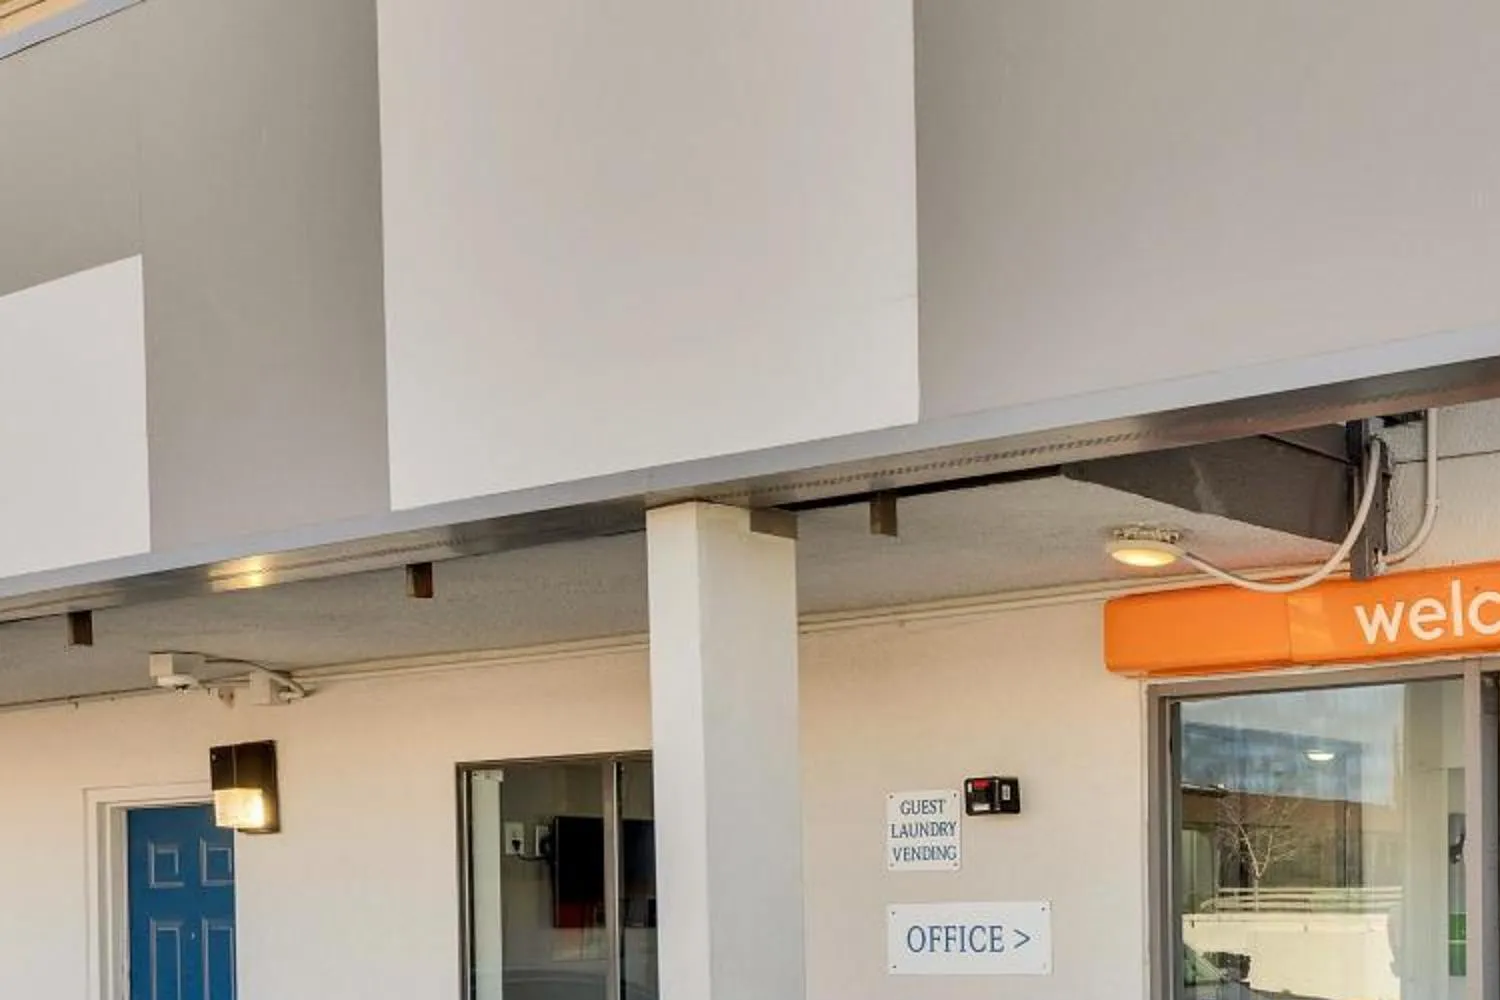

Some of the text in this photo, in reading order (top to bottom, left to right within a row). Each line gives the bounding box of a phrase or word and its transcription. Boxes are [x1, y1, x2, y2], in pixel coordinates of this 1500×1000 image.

[901, 800, 946, 815] GUEST
[891, 822, 957, 838] LAUNDRY
[892, 846, 957, 862] VENDING
[907, 925, 1004, 953] OFFICE
